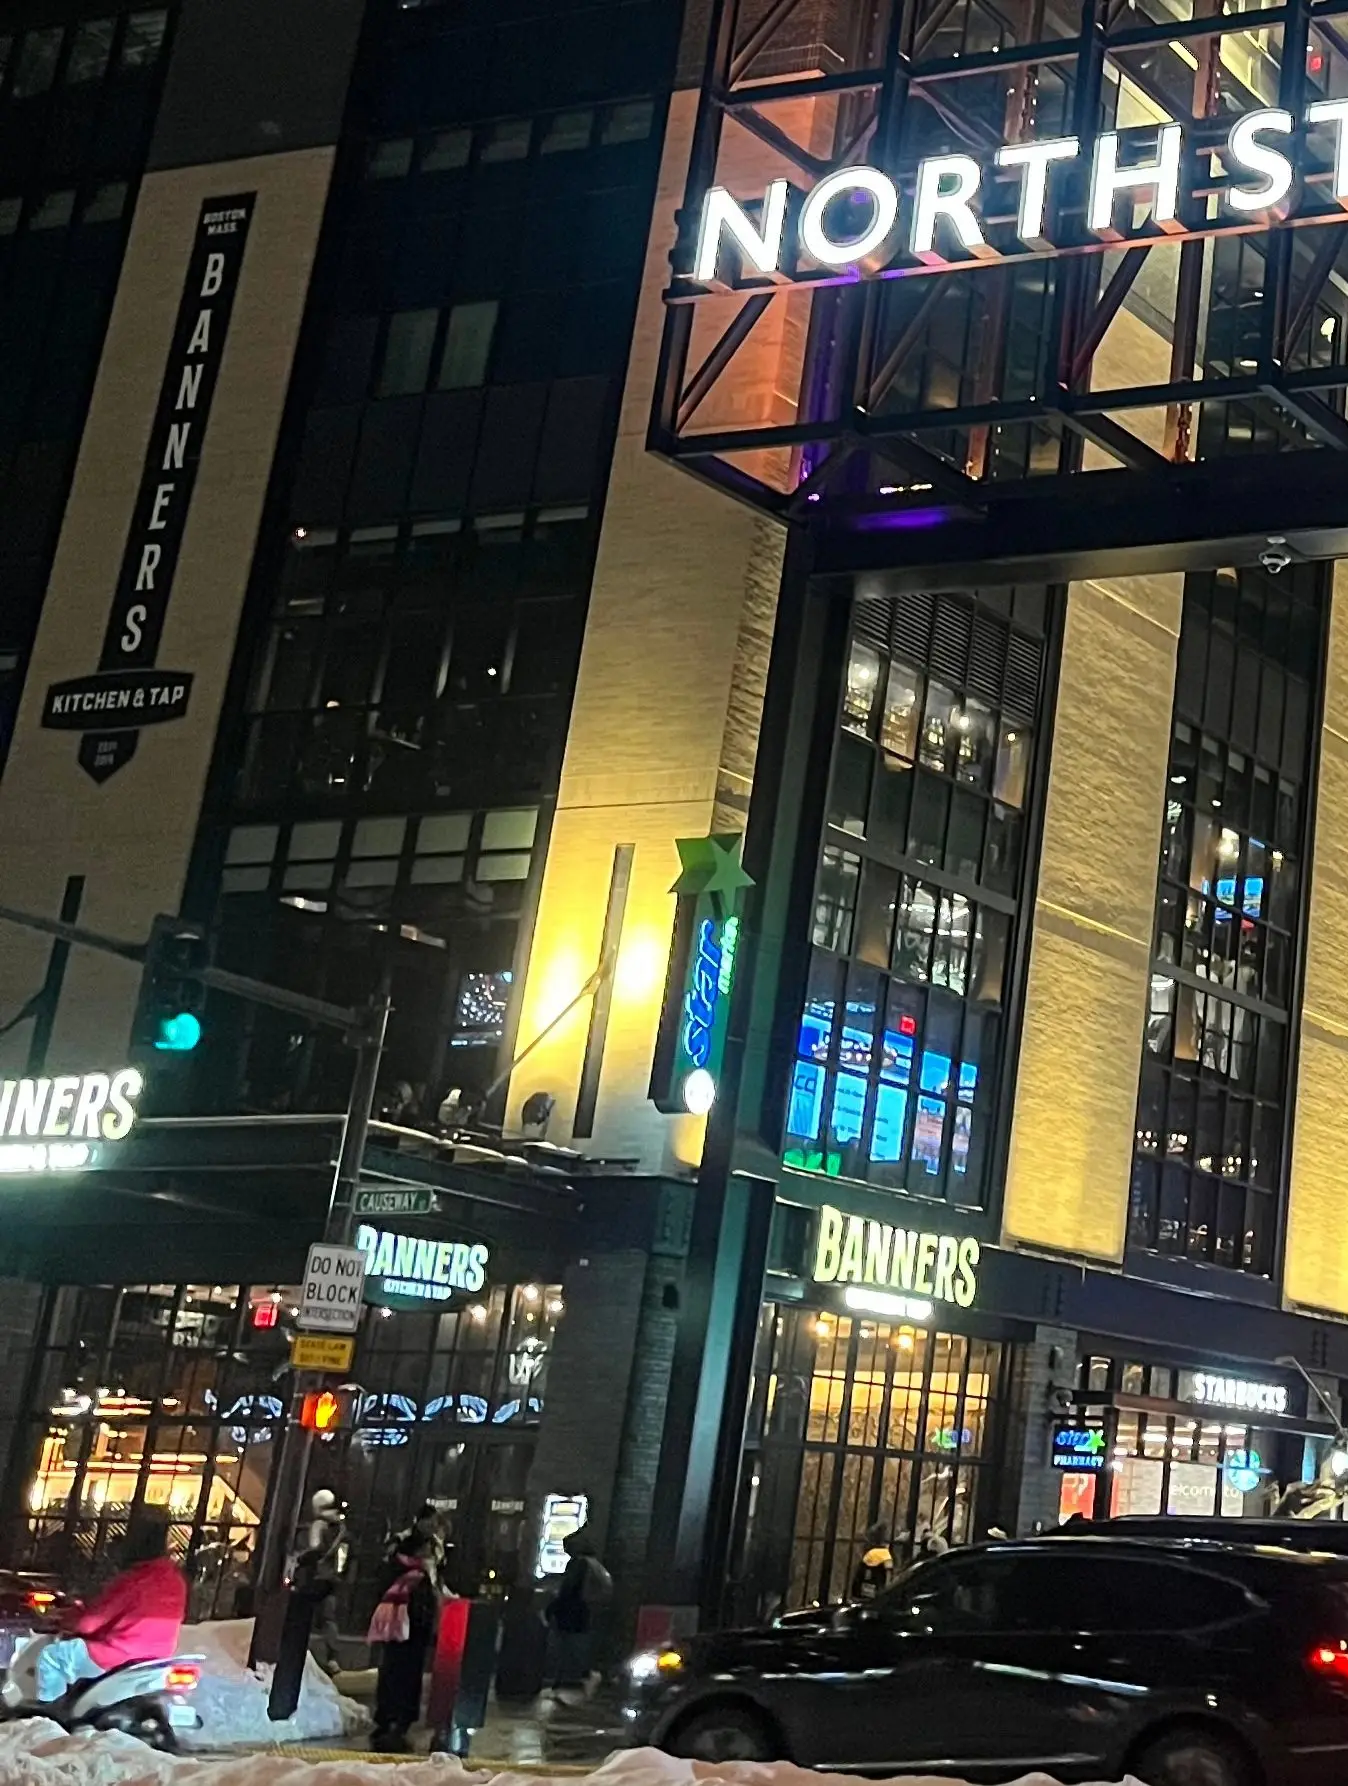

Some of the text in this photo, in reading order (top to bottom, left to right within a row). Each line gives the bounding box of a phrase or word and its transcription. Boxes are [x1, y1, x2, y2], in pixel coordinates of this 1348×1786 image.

[697, 126, 1184, 282] NORTH
[121, 253, 225, 652] BANNERS
[52, 685, 185, 714] KITCHEN & TAP
[360, 1192, 418, 1211] CAUSEWAY
[311, 1256, 362, 1278] DO NOT
[358, 1224, 489, 1292] BANNERS
[813, 1204, 980, 1308] BANNERS
[306, 1283, 358, 1303] BLOCK
[1193, 1372, 1287, 1413] STARBUCKS
[1053, 1454, 1105, 1469] PHARMACY
